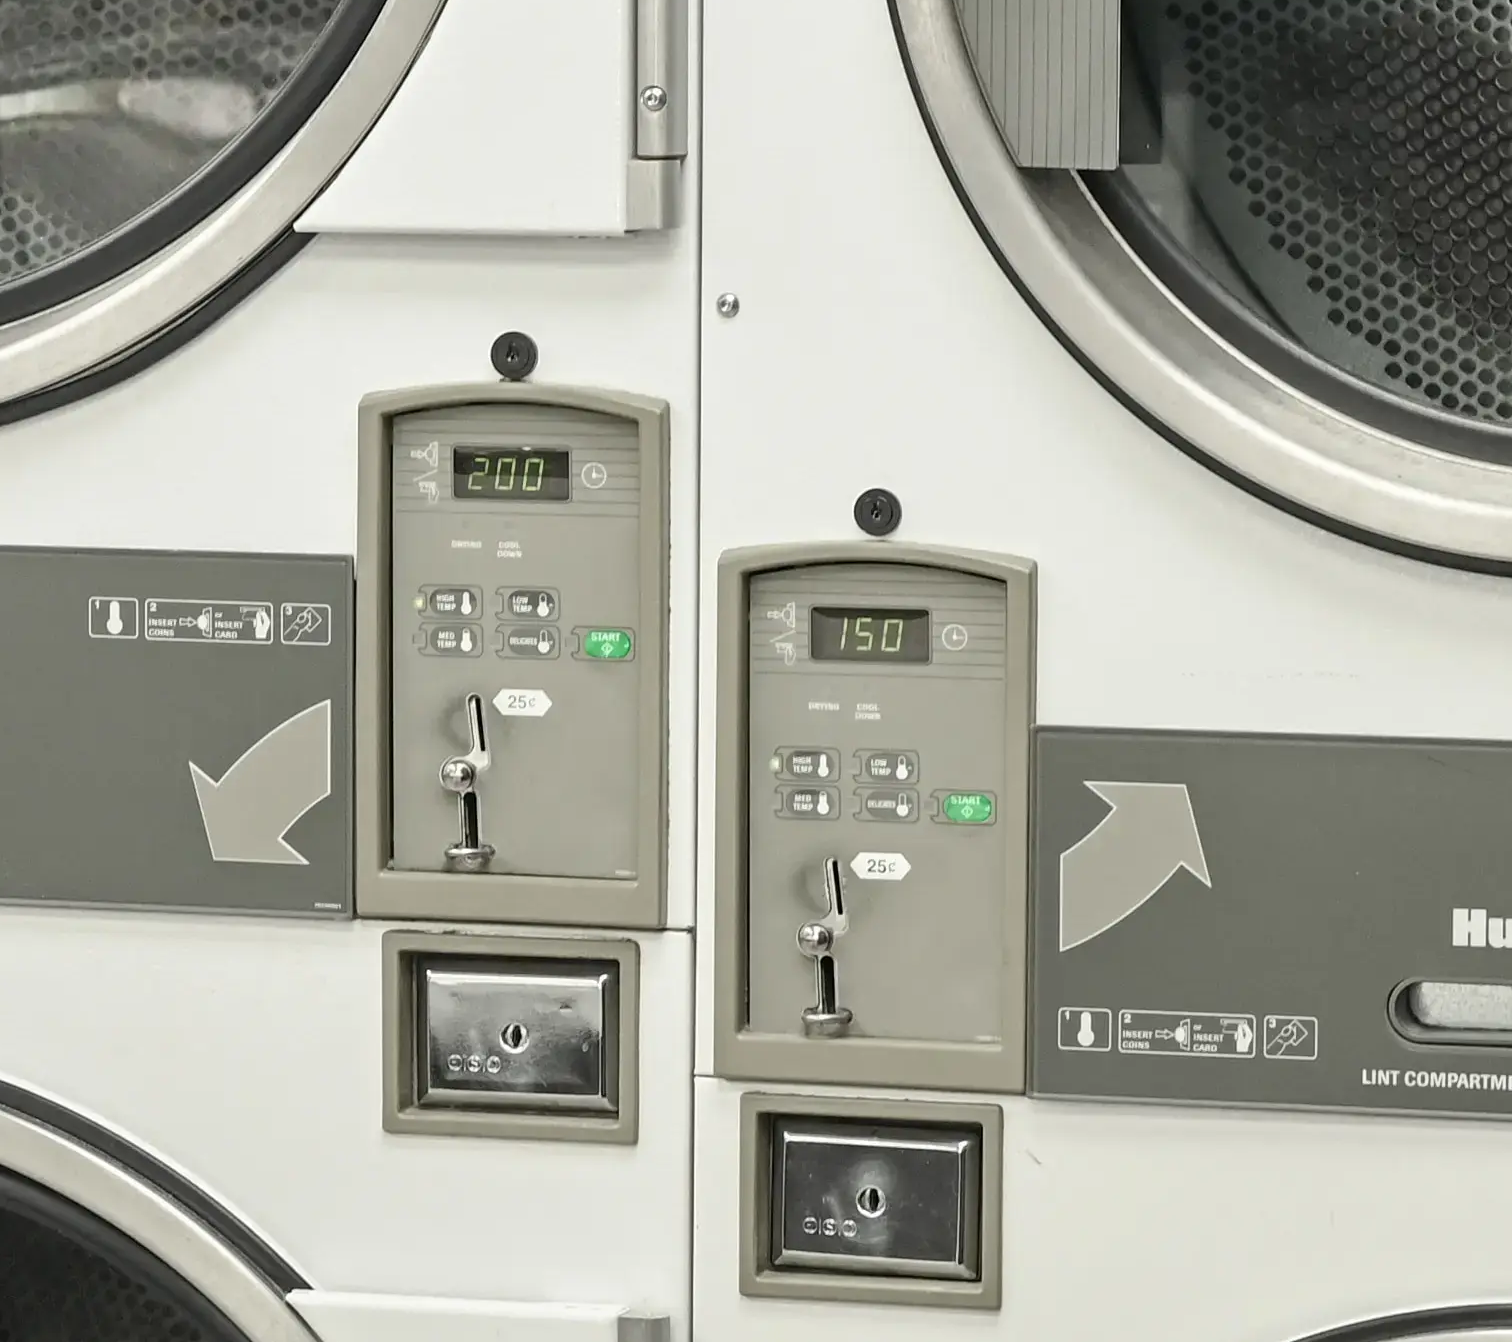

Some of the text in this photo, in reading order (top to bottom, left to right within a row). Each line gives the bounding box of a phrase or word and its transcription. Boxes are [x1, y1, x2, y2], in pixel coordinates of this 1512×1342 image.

[467, 457, 544, 491] 200
[512, 595, 529, 605] LOW
[436, 602, 457, 611] TEMP
[512, 604, 533, 613] TEMP
[148, 619, 177, 627] INSERT
[214, 620, 243, 629] INSERT
[438, 631, 455, 640] MED
[591, 632, 621, 643] START
[840, 616, 904, 652] 150
[436, 639, 457, 649] TEMP
[871, 759, 887, 768] LOW
[792, 764, 813, 774] TEMP
[871, 766, 892, 776] TEMP
[950, 795, 981, 806] START
[792, 802, 814, 812] TEMP
[1123, 1013, 1131, 1023] 2
[1268, 1018, 1276, 1028] 3
[1123, 1030, 1153, 1040] INSERT
[1193, 1034, 1224, 1043] INSERT
[1193, 1043, 1218, 1052] CARD
[1362, 1069, 1400, 1086] LINT
